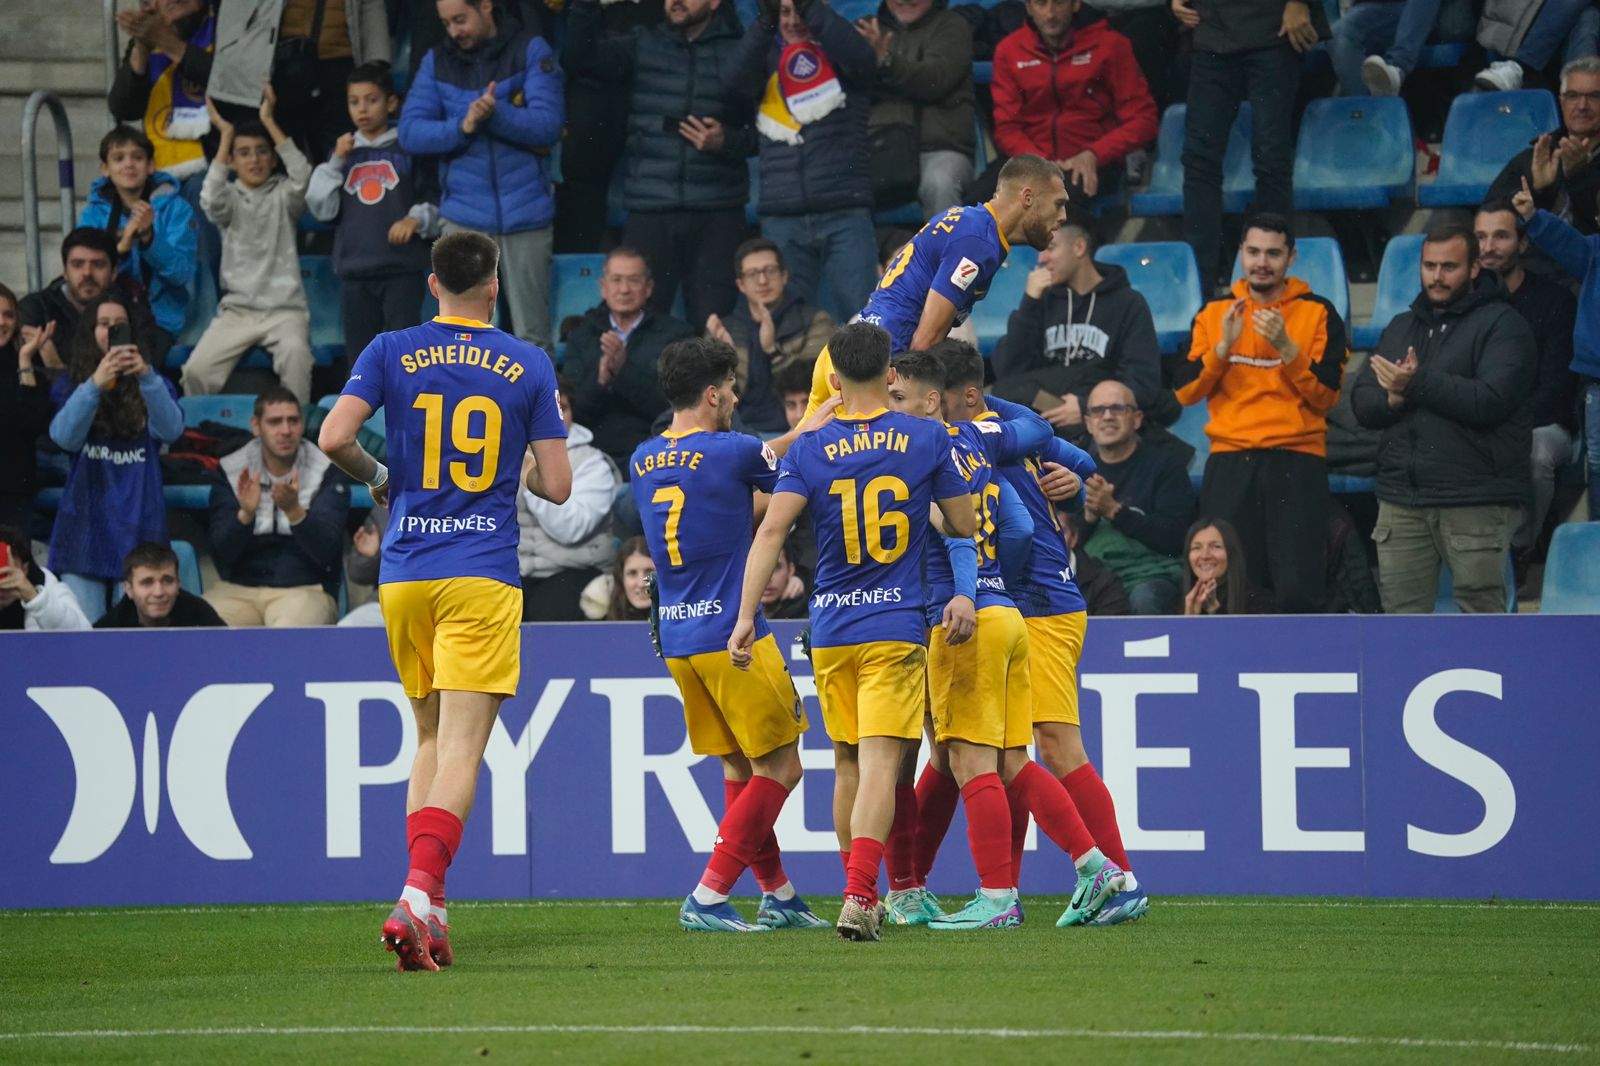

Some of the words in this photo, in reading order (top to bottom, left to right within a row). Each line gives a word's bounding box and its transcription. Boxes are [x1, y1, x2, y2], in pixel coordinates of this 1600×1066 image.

[401, 345, 525, 384] SCHEIDLER
[412, 393, 502, 493] 19
[635, 451, 704, 477] LOBETE
[824, 428, 910, 461] PAMPÍN
[651, 485, 685, 566] 7
[828, 475, 910, 565] 16
[305, 635, 1516, 858] PYRÉES
